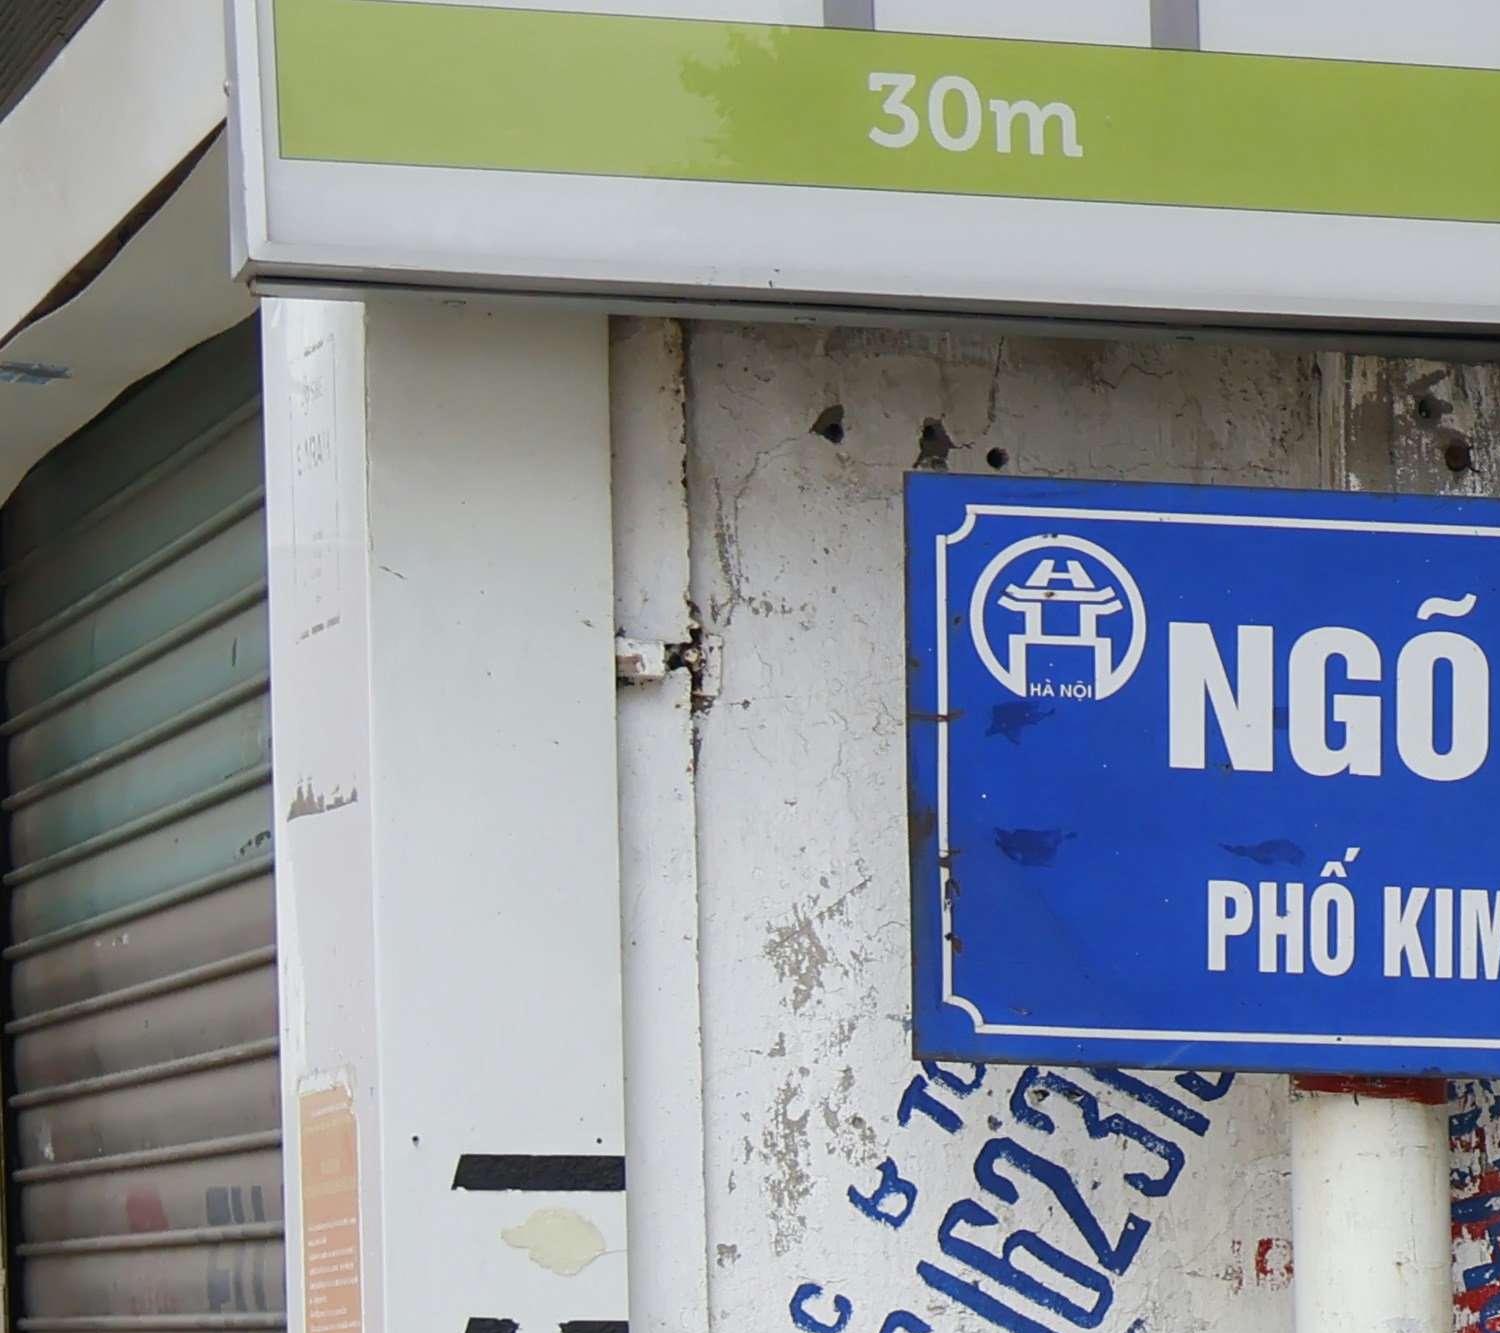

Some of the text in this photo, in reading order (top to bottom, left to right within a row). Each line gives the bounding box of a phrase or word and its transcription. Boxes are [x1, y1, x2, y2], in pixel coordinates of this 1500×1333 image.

[868, 72, 1084, 158] 30m
[1029, 677, 1095, 704] HÀ NỘI
[1168, 593, 1491, 782] NGÕ
[1207, 847, 1361, 976] PHỐ
